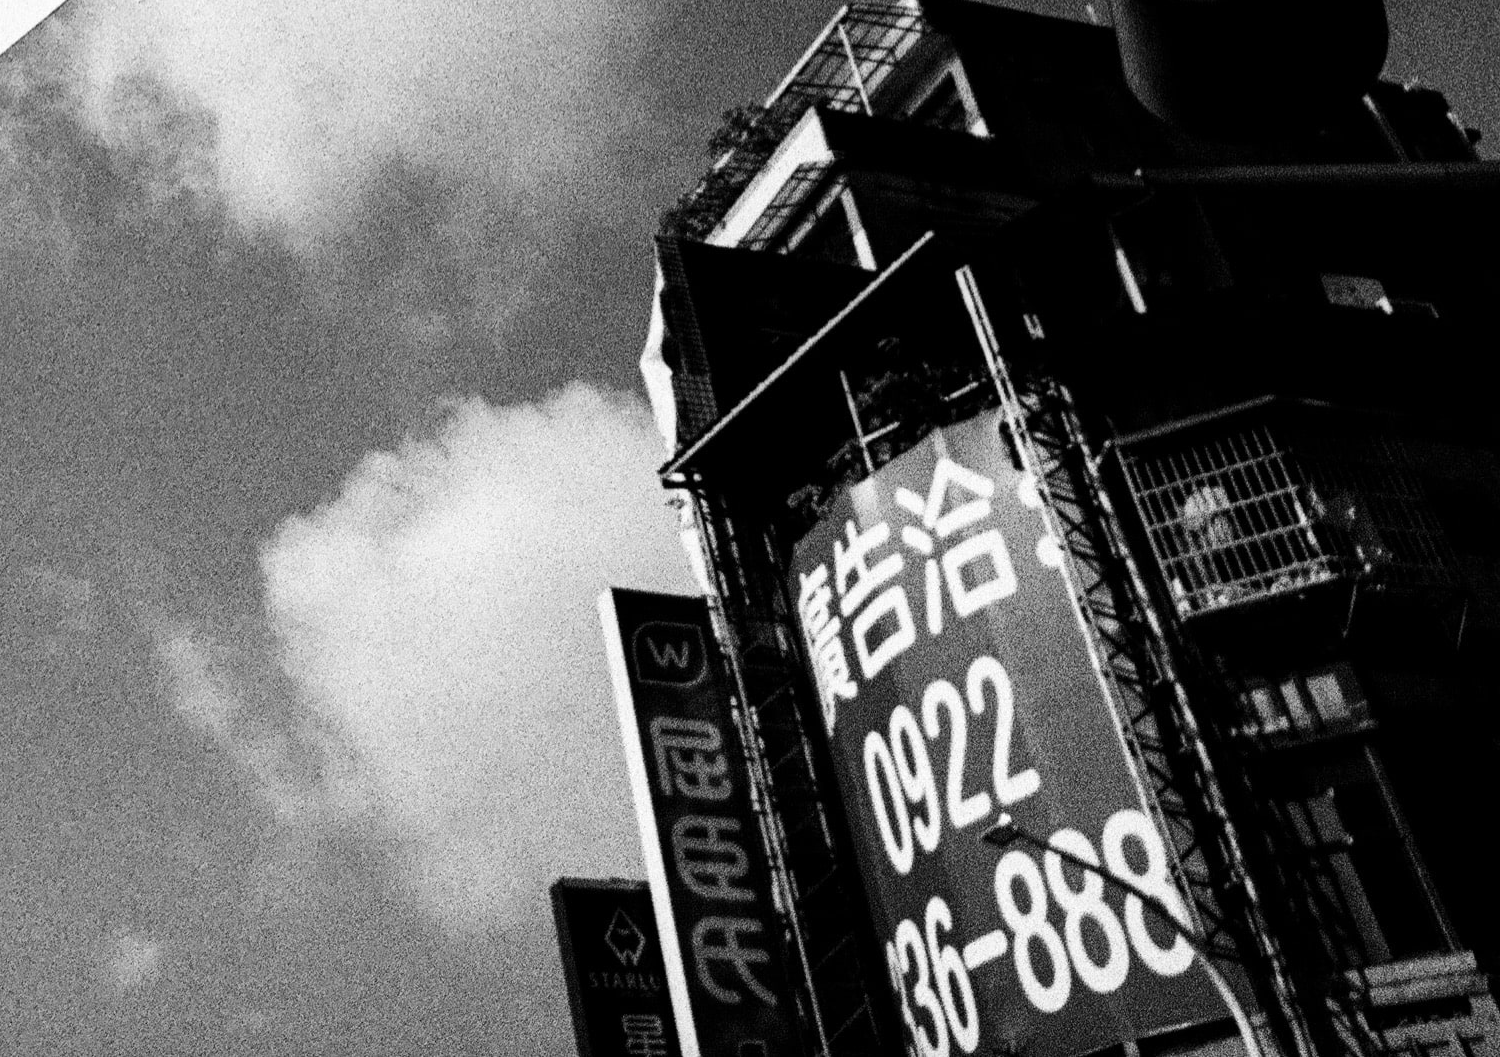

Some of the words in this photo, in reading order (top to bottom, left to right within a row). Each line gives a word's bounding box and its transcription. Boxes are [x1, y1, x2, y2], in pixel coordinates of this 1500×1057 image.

[650, 715, 777, 1007] 屈臣氏
[863, 655, 1040, 875] 0922
[588, 972, 662, 990] STARLU
